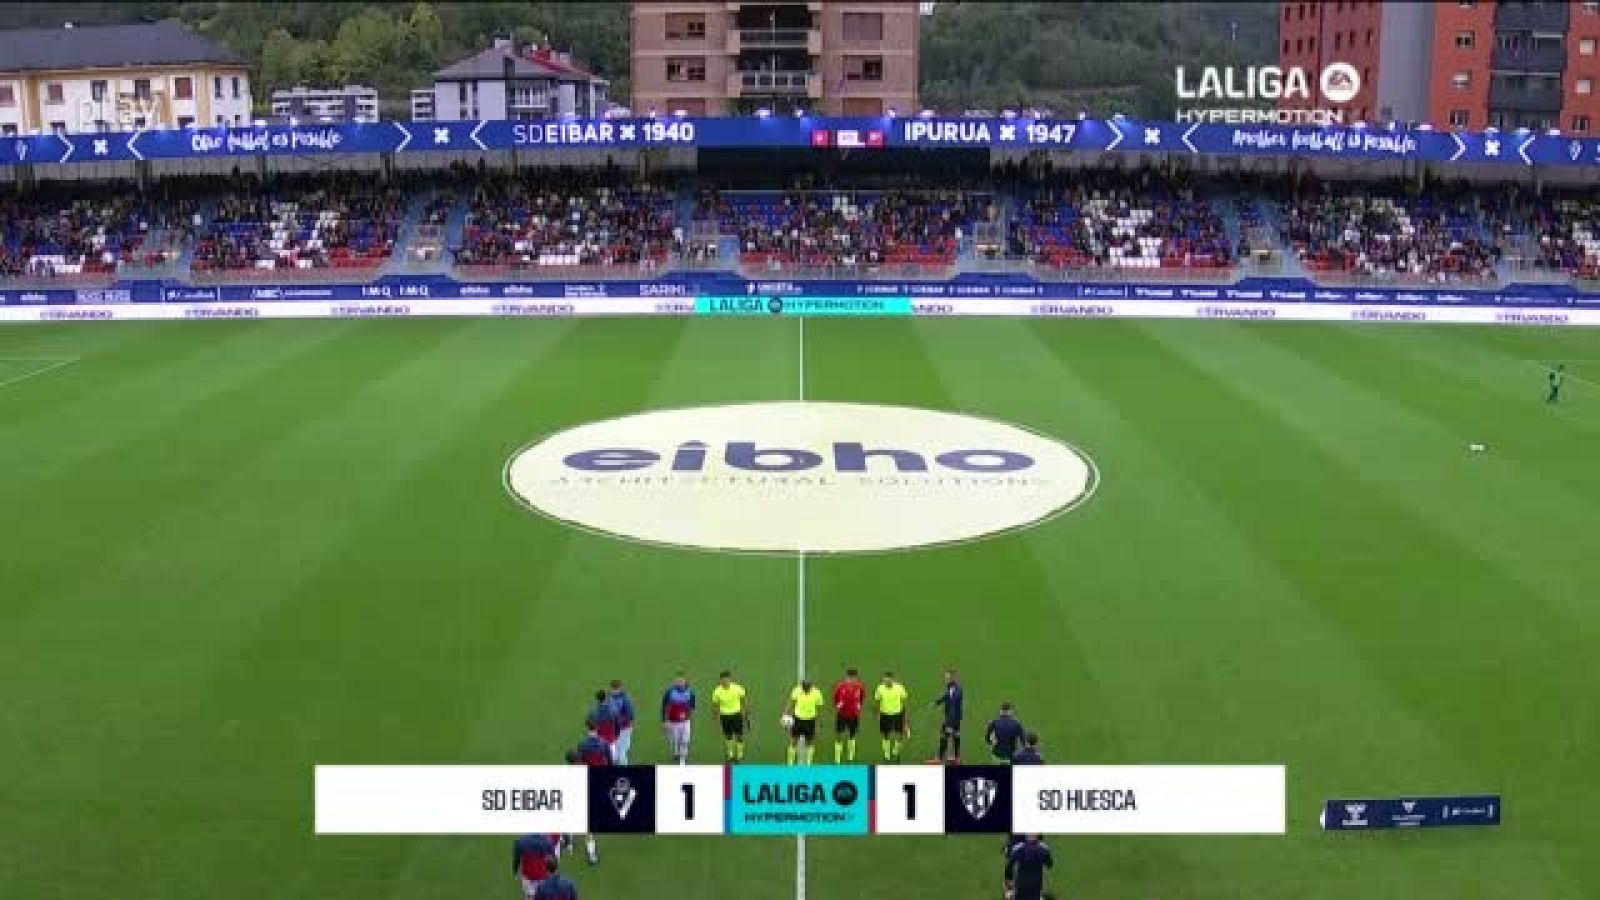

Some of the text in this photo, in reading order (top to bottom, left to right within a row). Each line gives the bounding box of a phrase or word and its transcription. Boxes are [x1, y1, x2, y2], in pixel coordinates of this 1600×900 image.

[642, 122, 694, 142] 1940
[904, 122, 1076, 144] IPURUA 1947
[709, 297, 763, 312] LALIGA
[562, 440, 1036, 472] eibho
